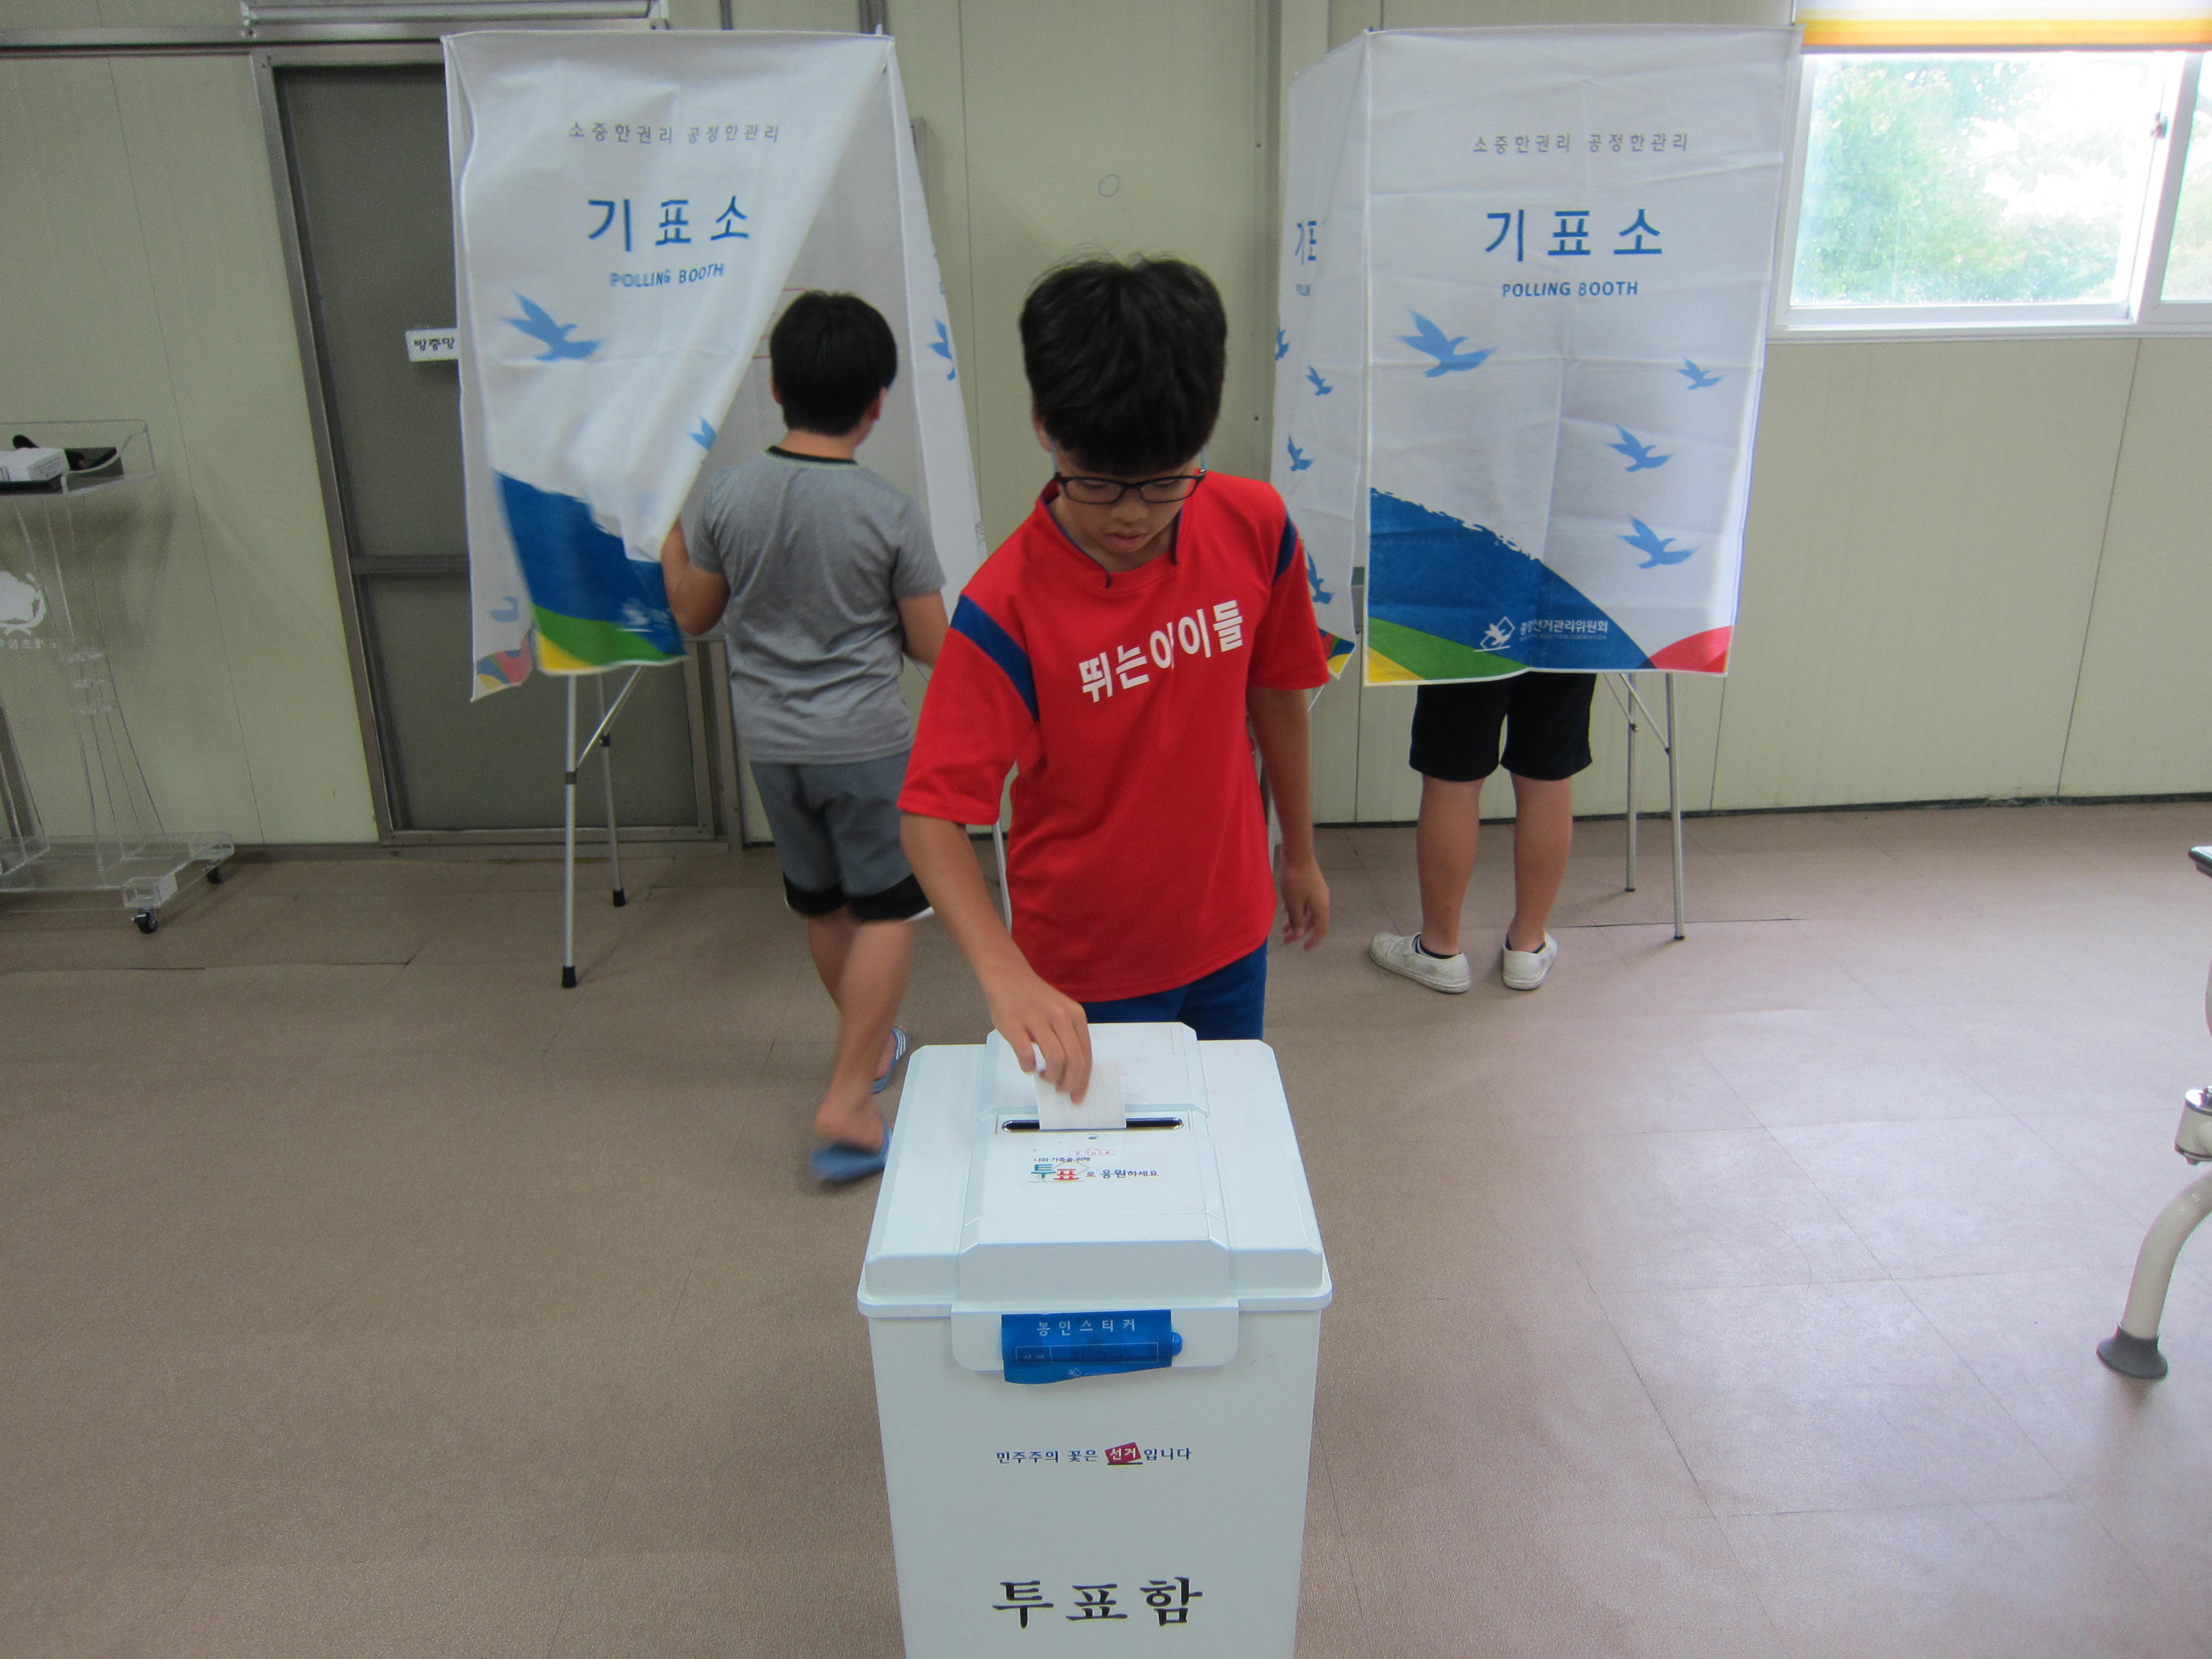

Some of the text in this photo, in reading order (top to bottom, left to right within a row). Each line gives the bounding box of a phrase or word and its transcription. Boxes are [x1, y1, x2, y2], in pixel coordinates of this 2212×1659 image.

[569, 122, 779, 144] 소중한권리 공정한관리
[1473, 133, 1688, 154] 소중한권리 공정한관리
[588, 195, 749, 252] 기표소
[1485, 208, 1663, 262] 기표소
[610, 263, 725, 288] POLLING BOOTH
[1502, 281, 1639, 298] POLLING BOOTH
[1036, 1318, 1135, 1337] 봉인스티커
[996, 1450, 1060, 1464] 민주주의
[1067, 1449, 1099, 1463] 꽃은
[992, 1575, 1204, 1629] 투표함
